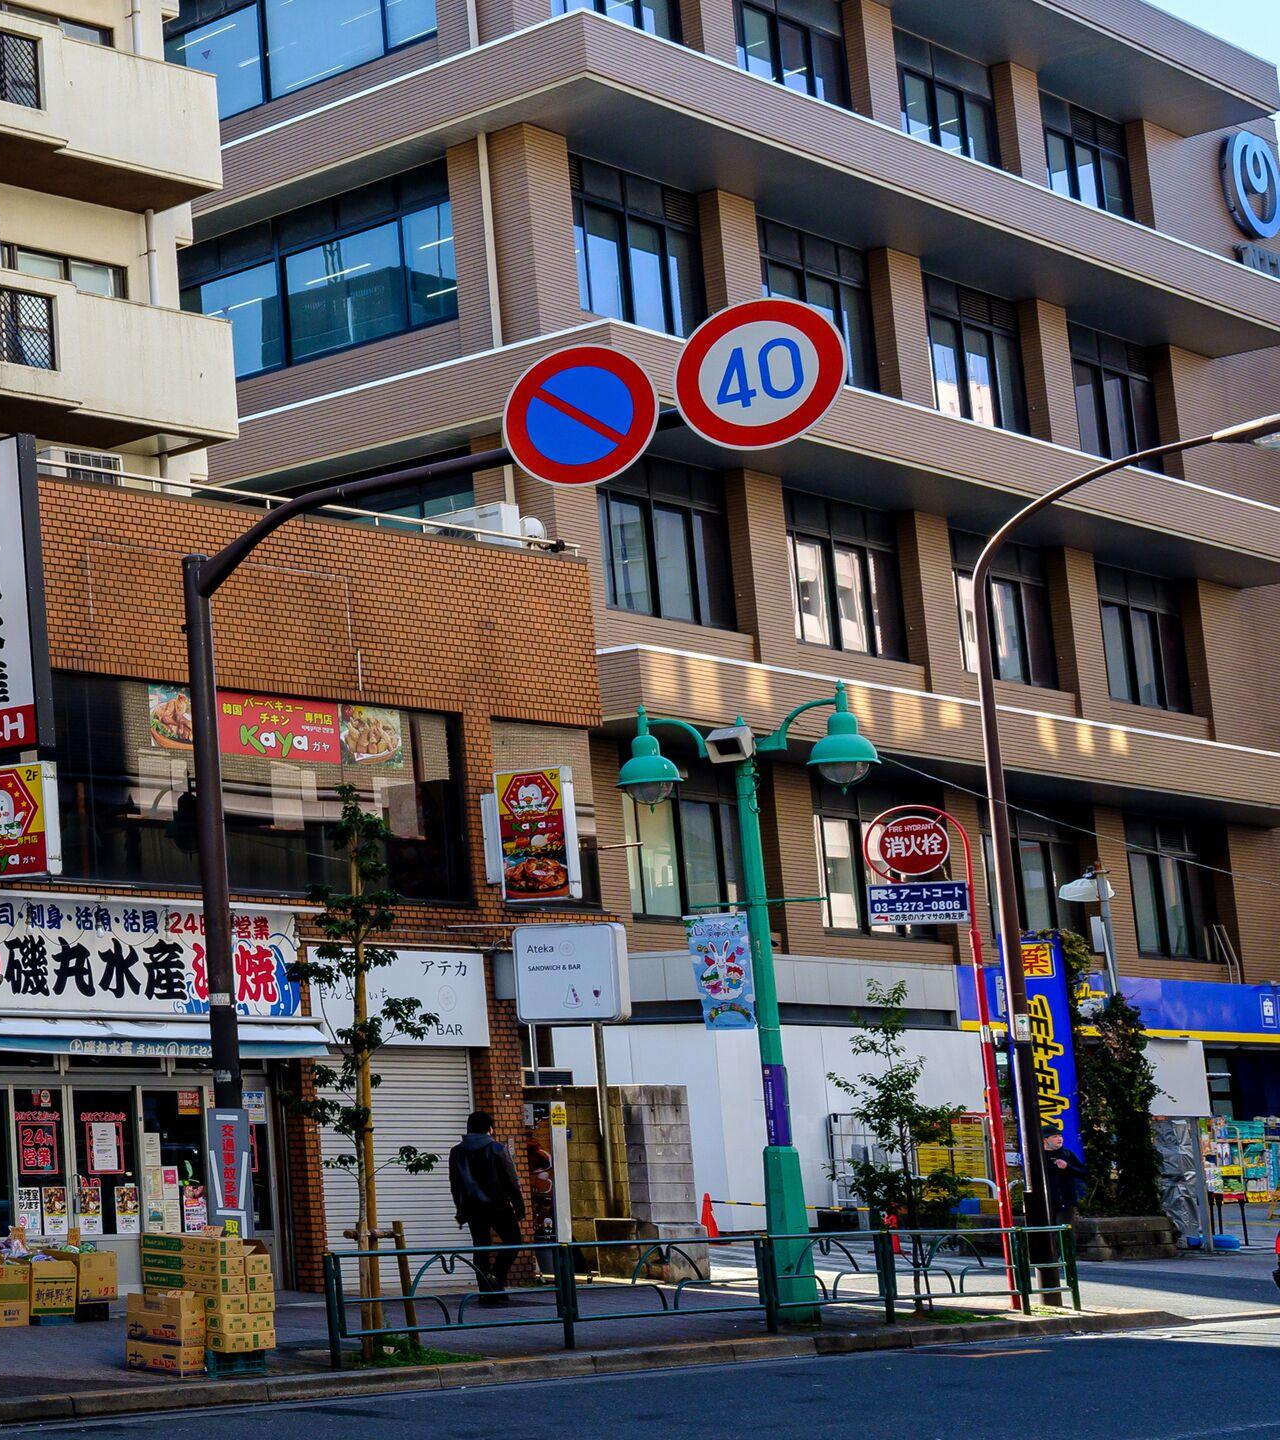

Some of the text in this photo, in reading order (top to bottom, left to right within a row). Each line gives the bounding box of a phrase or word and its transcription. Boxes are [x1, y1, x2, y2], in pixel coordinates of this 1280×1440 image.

[716, 337, 804, 408] 40
[222, 698, 333, 726] 韓国 バーベキュー 専門店
[259, 712, 290, 727] チキン
[240, 724, 330, 758] Kaya ガヤ
[25, 769, 38, 781] 2F
[889, 823, 934, 833] FIRE HYDRANT
[884, 832, 943, 858] 消火栓
[899, 886, 963, 899] アートコート
[874, 900, 960, 912] 03-5273-0806
[169, 911, 270, 940] 24営業
[526, 944, 555, 954] Ateka
[421, 960, 467, 976] アテカ
[527, 964, 560, 972] SANDWICH
[568, 963, 581, 971] BAR
[436, 1024, 464, 1036] BAR
[24, 1147, 51, 1167] 営業
[221, 1124, 238, 1209] 交通事故多発
[35, 1288, 73, 1302] 新鮮野菜
[98, 1287, 115, 1296] レタス
